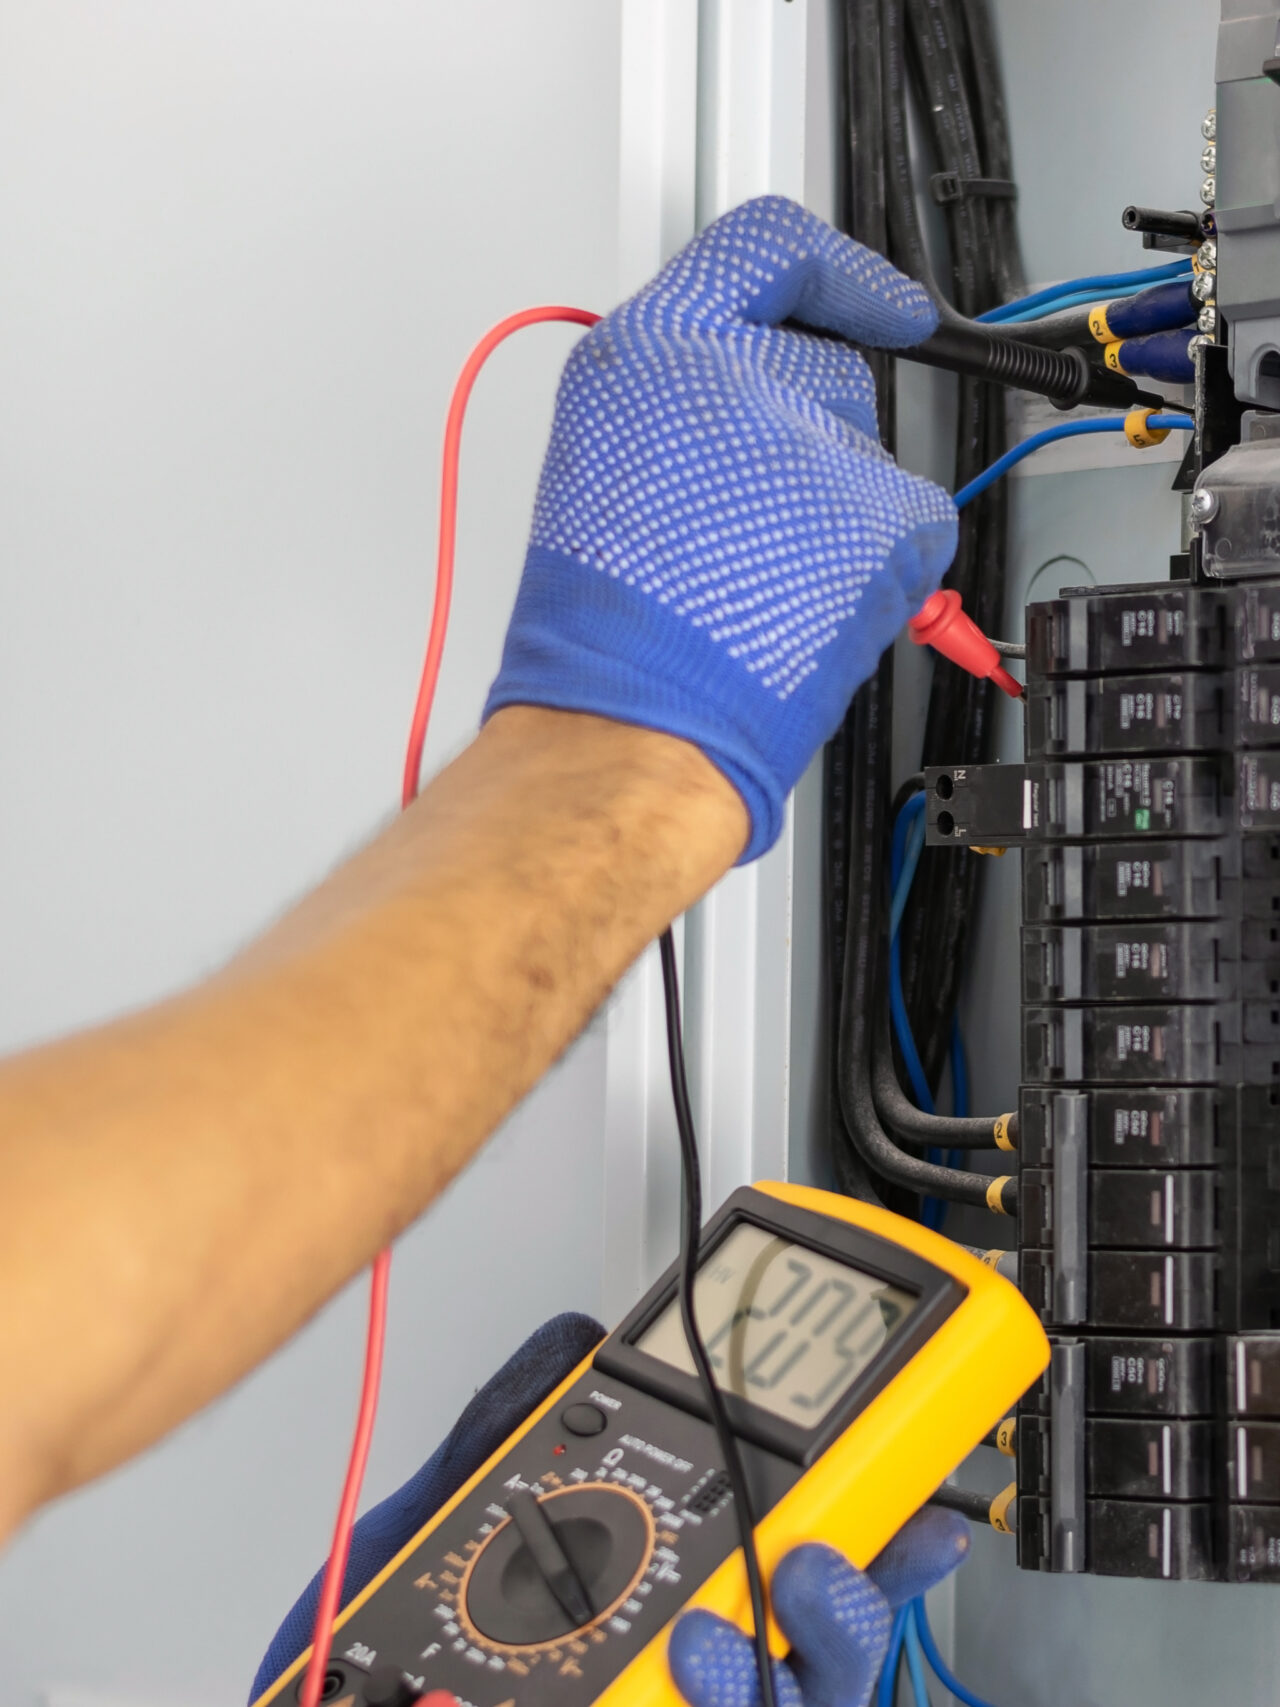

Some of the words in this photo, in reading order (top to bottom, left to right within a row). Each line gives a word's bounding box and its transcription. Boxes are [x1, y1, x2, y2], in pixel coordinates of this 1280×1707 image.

[1093, 321, 1103, 337] 2
[1110, 353, 1117, 368] 3
[1133, 434, 1146, 446] 5
[958, 770, 966, 779] N
[958, 829, 967, 837] L
[996, 1123, 1003, 1139] 2
[589, 1390, 622, 1410] POWER
[1000, 1431, 1007, 1446] 3
[618, 1434, 646, 1450] AUTO
[645, 1444, 676, 1465] POWER
[672, 1458, 694, 1473] OFF
[344, 1642, 377, 1667] 20A
[420, 1642, 441, 1659] F
